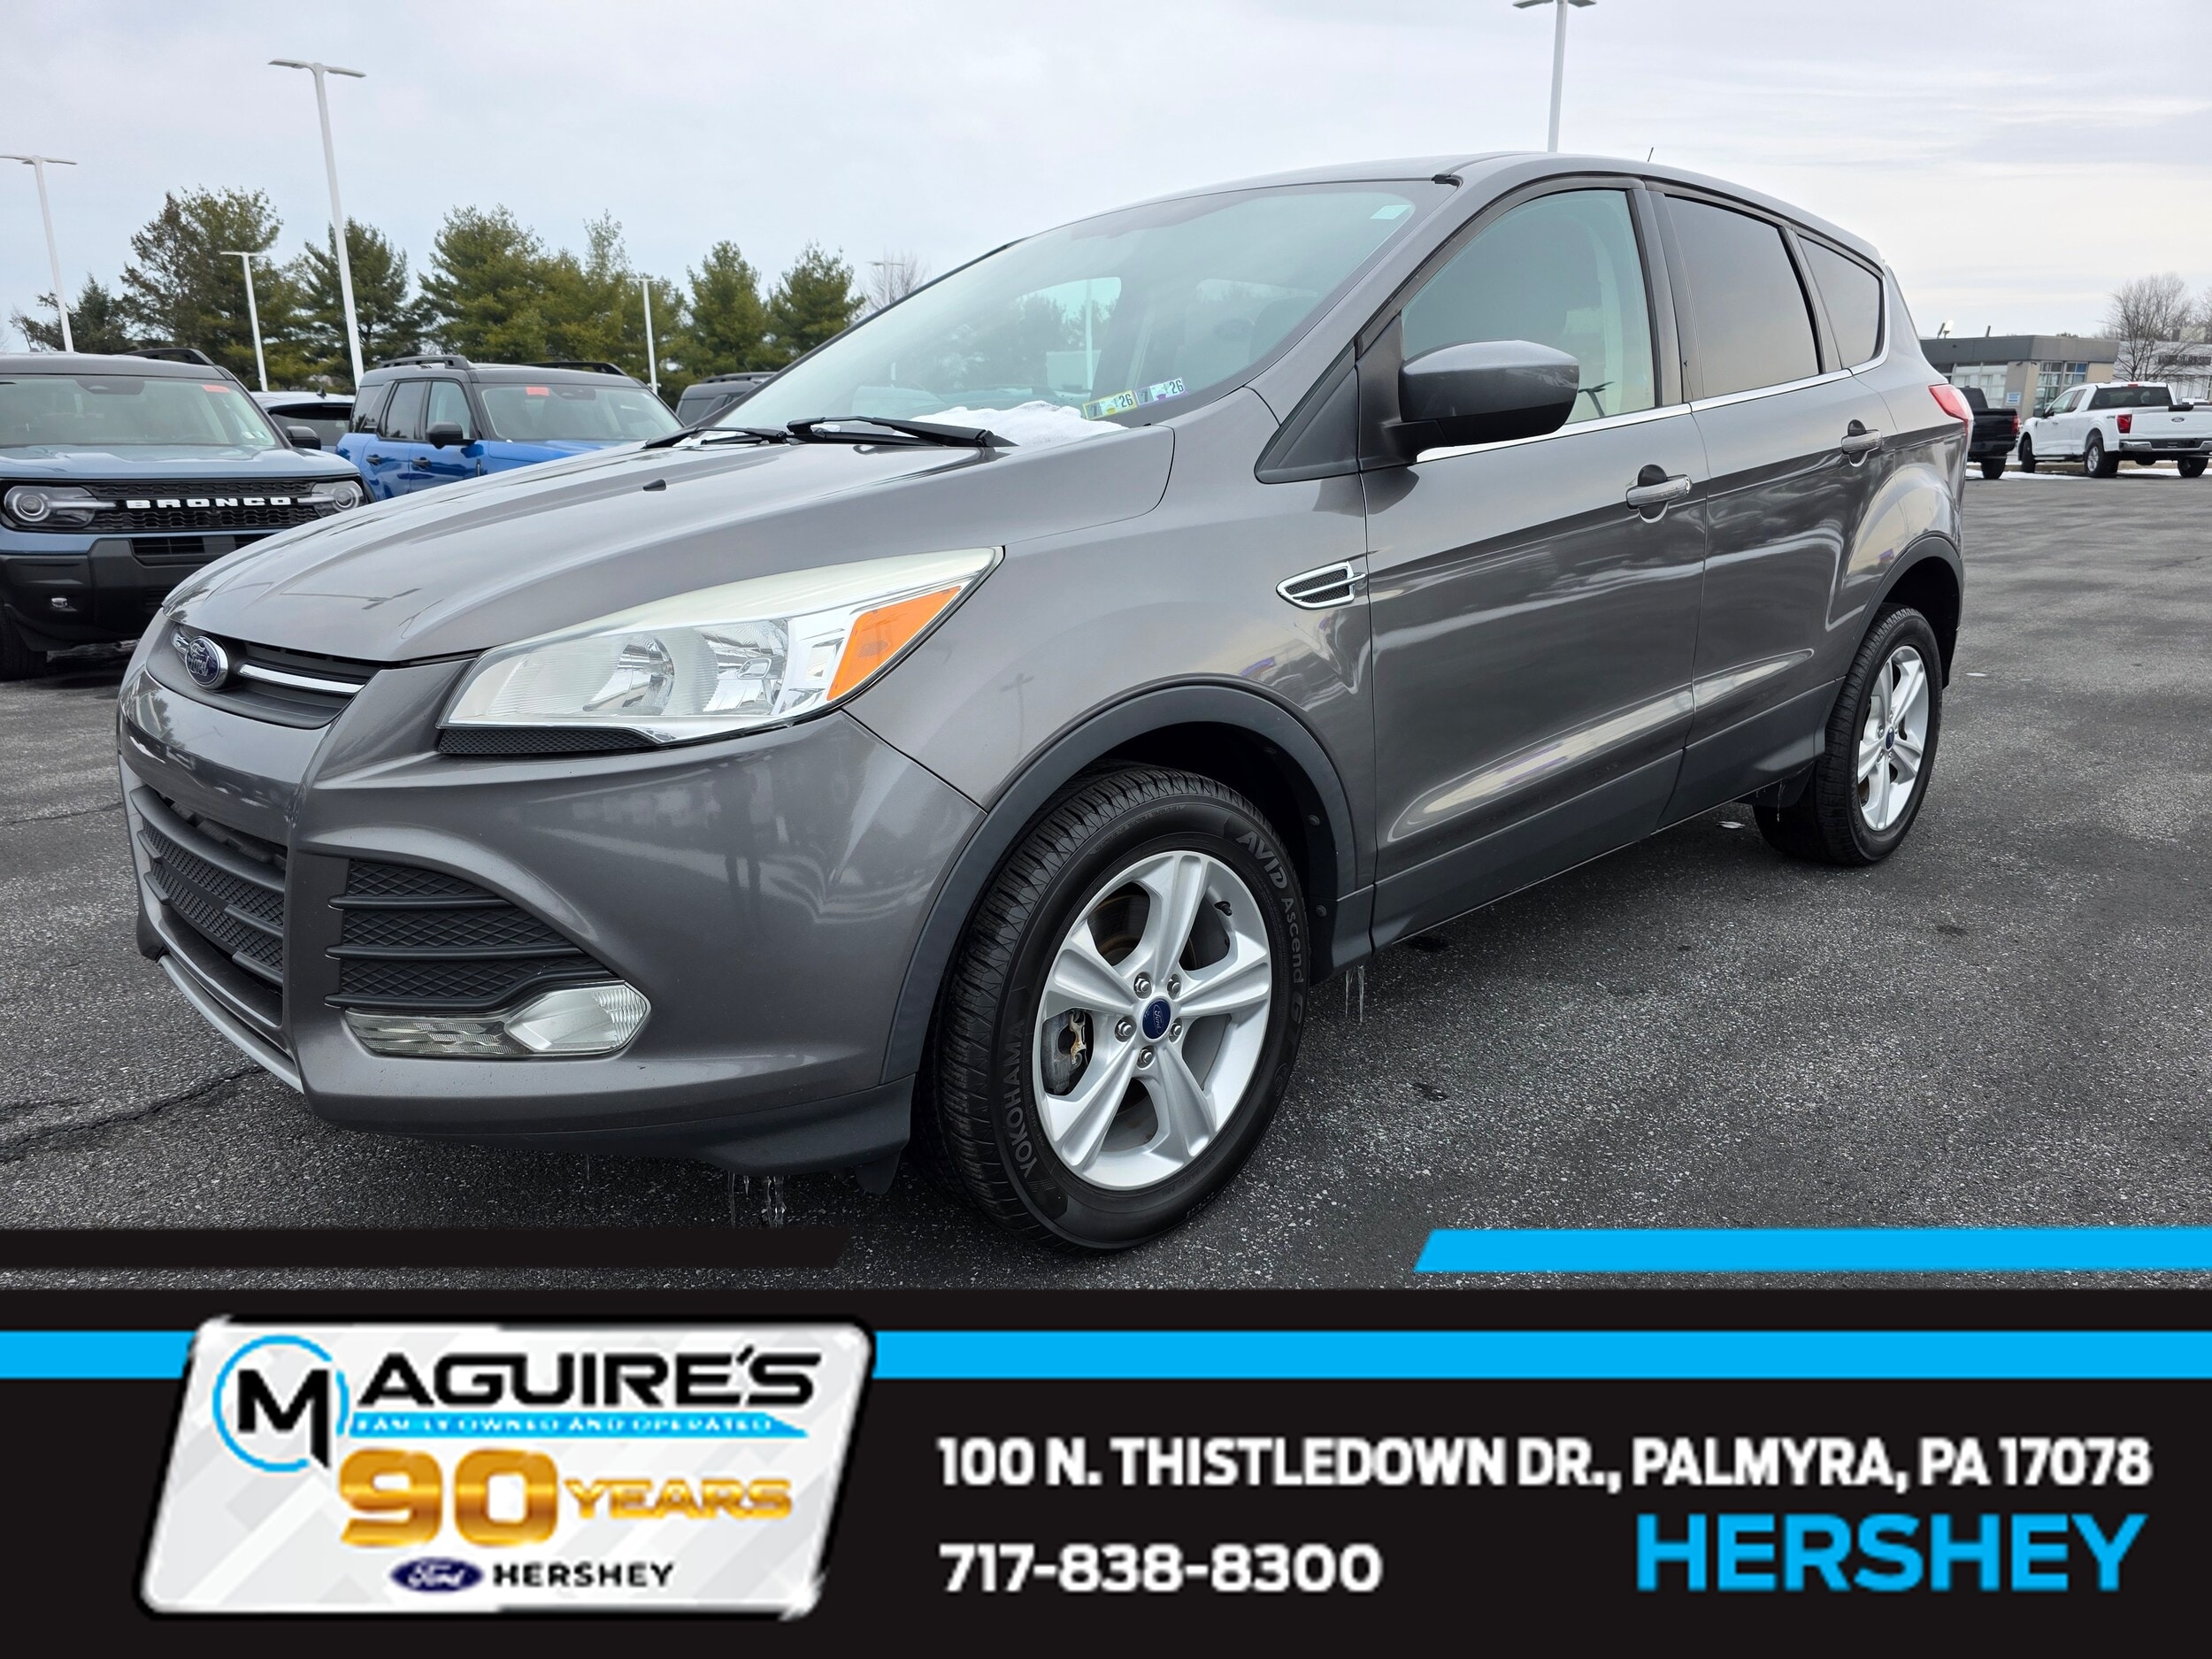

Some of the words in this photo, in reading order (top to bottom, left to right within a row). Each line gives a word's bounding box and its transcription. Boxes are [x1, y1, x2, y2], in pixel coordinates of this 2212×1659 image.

[1170, 380, 1184, 395] 26
[1119, 394, 1133, 407] 26
[127, 497, 291, 510] BRONCO
[188, 641, 210, 677] Ford
[1237, 830, 1289, 889] AVID
[1280, 897, 1304, 984] Ascend
[1002, 1019, 1038, 1179] YOKOHAMA
